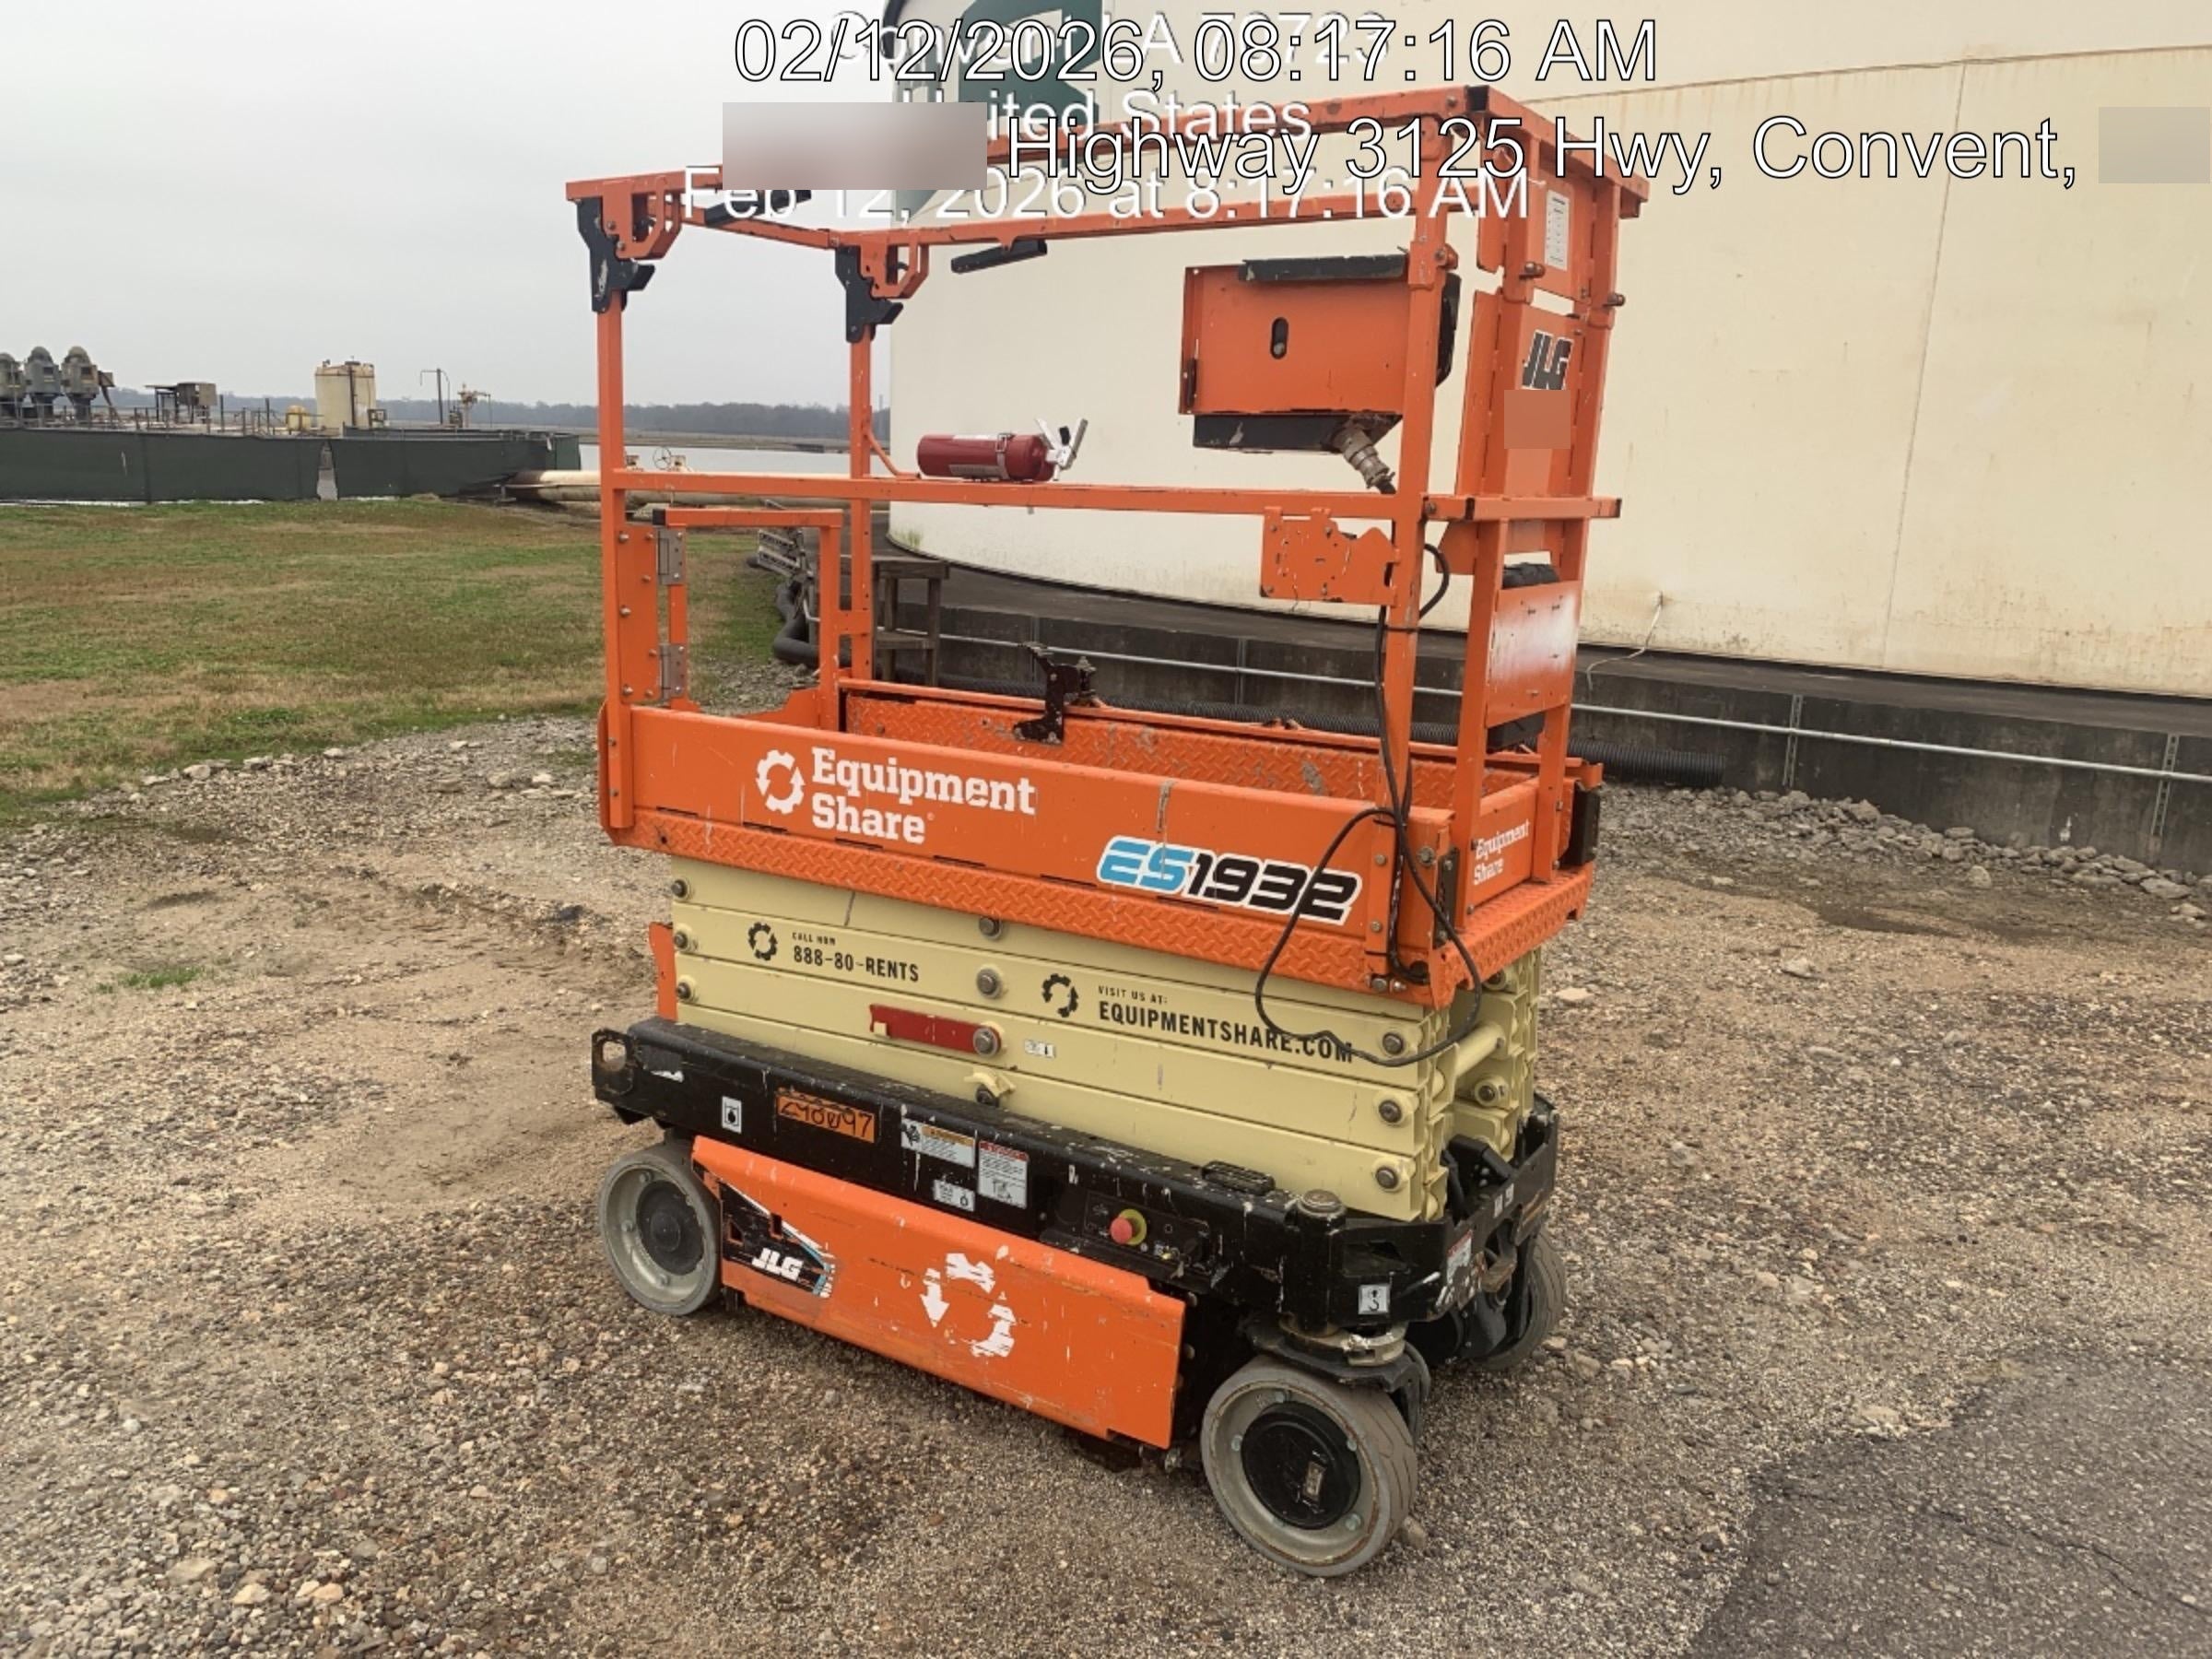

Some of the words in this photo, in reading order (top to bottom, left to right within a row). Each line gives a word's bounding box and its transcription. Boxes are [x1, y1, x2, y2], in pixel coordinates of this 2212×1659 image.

[1521, 329, 1574, 391] JLG
[811, 747, 1038, 816] Equipment
[812, 792, 925, 843] Share
[1474, 818, 1530, 860] Equipment
[1098, 836, 1361, 924] ES1932
[1474, 858, 1504, 885] Share
[794, 945, 919, 982] 888-80-RENTS
[1098, 985, 1127, 998] VISIT
[1131, 990, 1146, 1002] US
[1099, 1000, 1353, 1064] EQUIPMENTSHARE.COM
[751, 1247, 804, 1282] JLG
